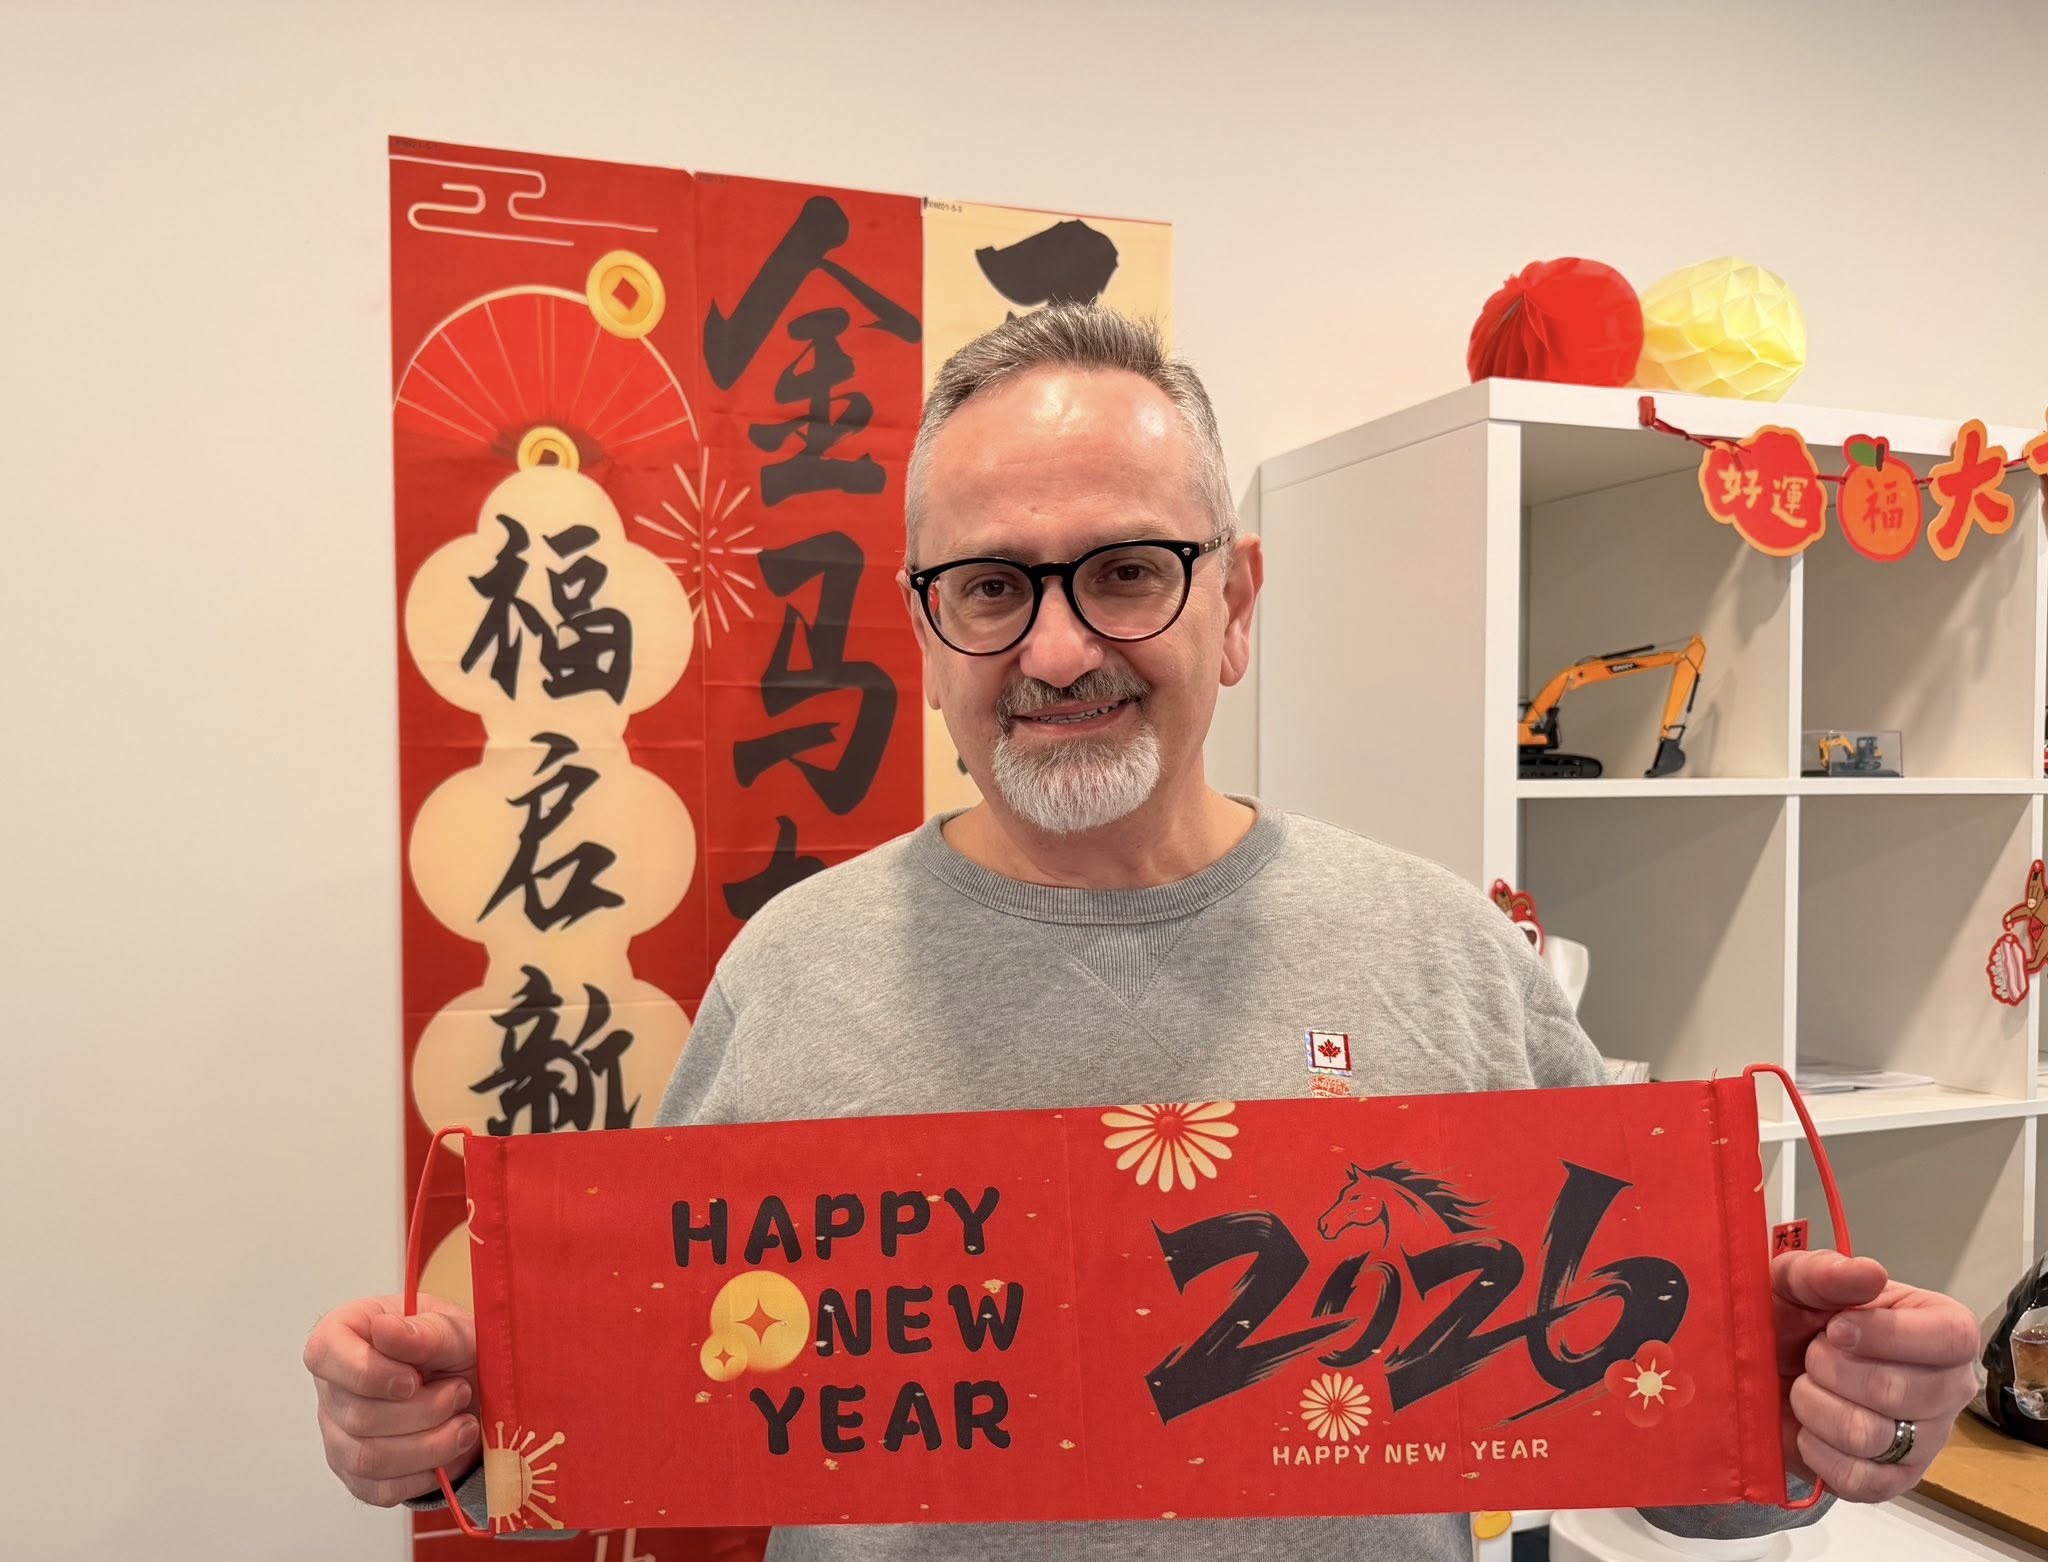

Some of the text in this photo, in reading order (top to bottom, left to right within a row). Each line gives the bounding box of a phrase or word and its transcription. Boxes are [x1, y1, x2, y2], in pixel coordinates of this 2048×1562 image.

[1717, 464, 1808, 529] 好運
[1861, 477, 1904, 535] 福
[1934, 428, 2010, 552] 大
[671, 1186, 1001, 1268] HAPPY
[815, 1281, 1025, 1357] NEW
[1144, 1159, 1690, 1427] 2026
[749, 1379, 1012, 1455] YEAR
[1272, 1438, 1550, 1466] HAPPY NEW YEAR
